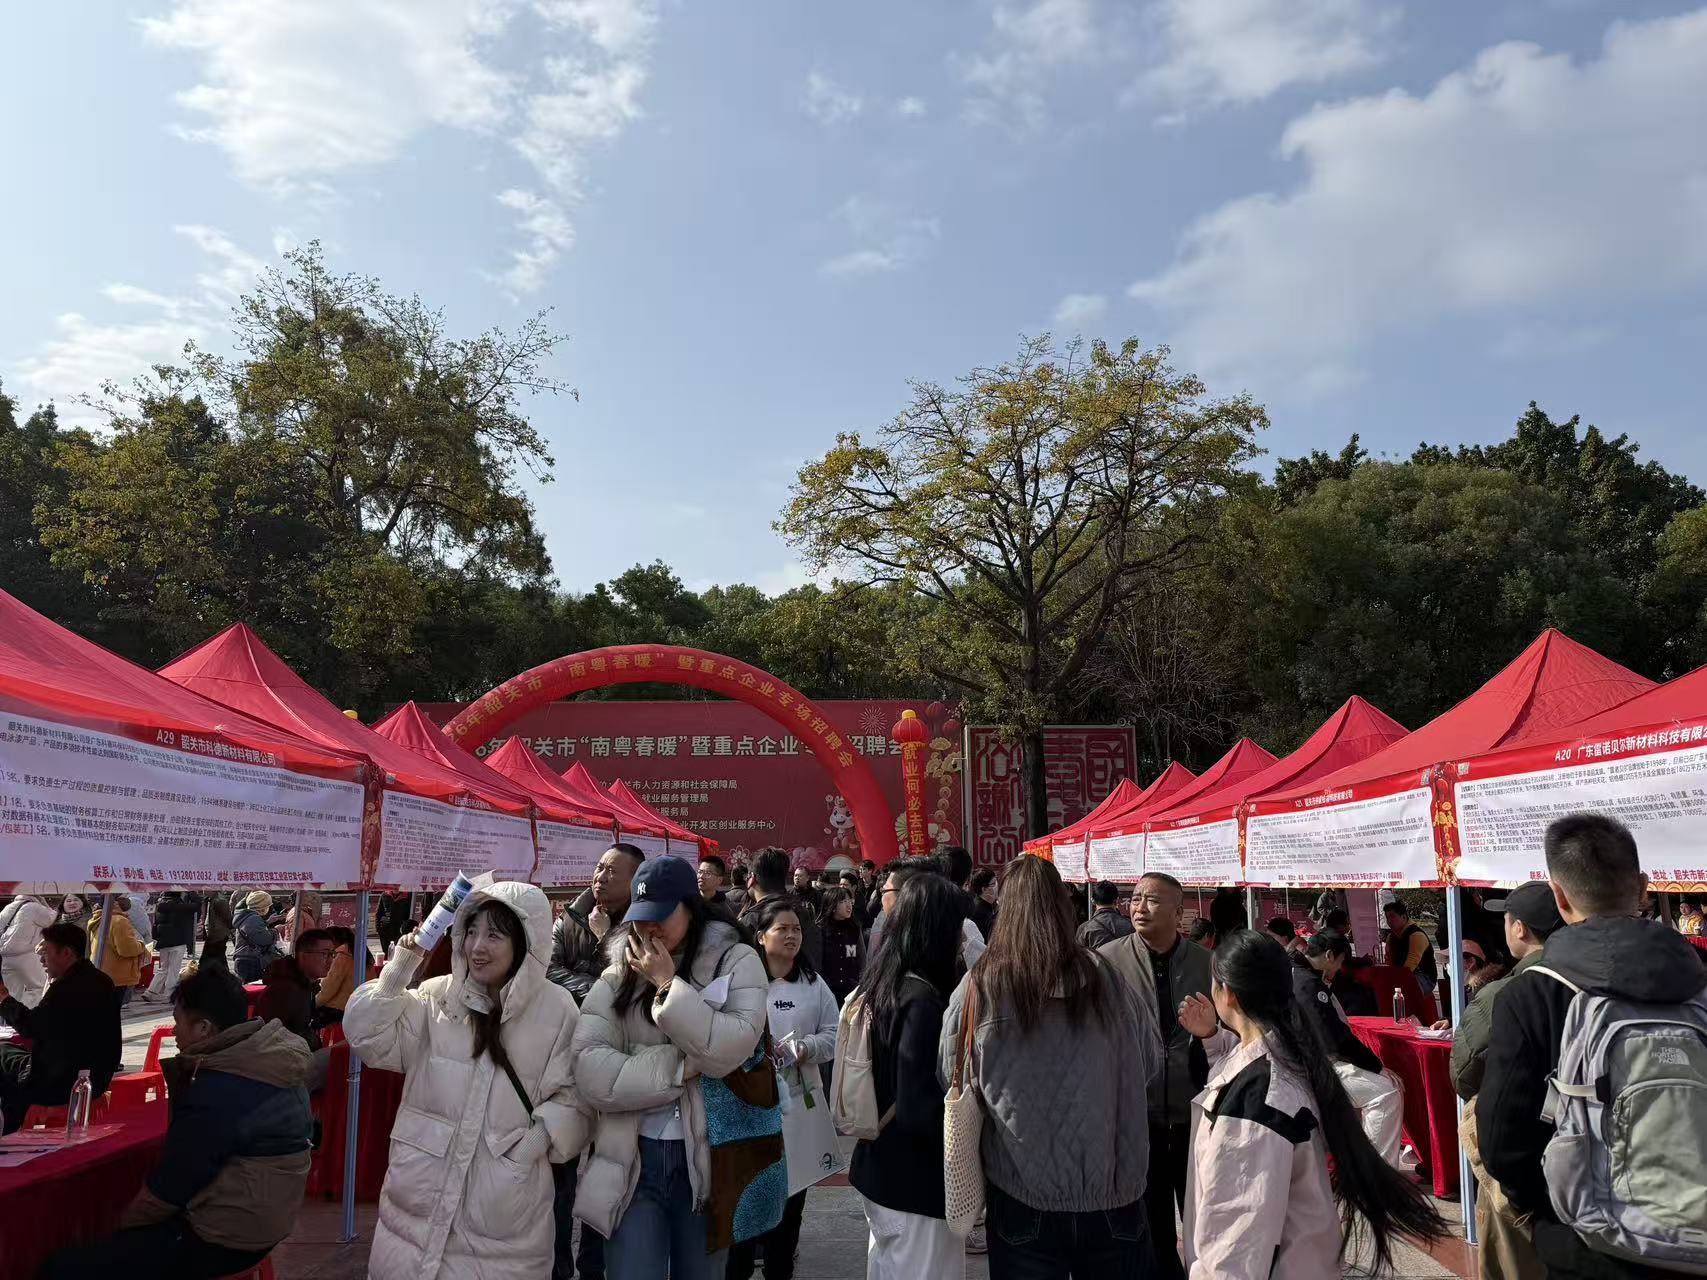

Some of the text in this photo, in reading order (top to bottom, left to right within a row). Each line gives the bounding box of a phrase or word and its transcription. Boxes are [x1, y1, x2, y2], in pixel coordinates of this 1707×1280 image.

[156, 729, 276, 766] A29 韶关市科德新材料有限公司
[1555, 748, 1571, 761] A20
[656, 807, 689, 817] 服务局
[676, 820, 776, 830] 业开发区创业服务中心
[1529, 870, 1548, 880] 联系人
[845, 943, 857, 958] M
